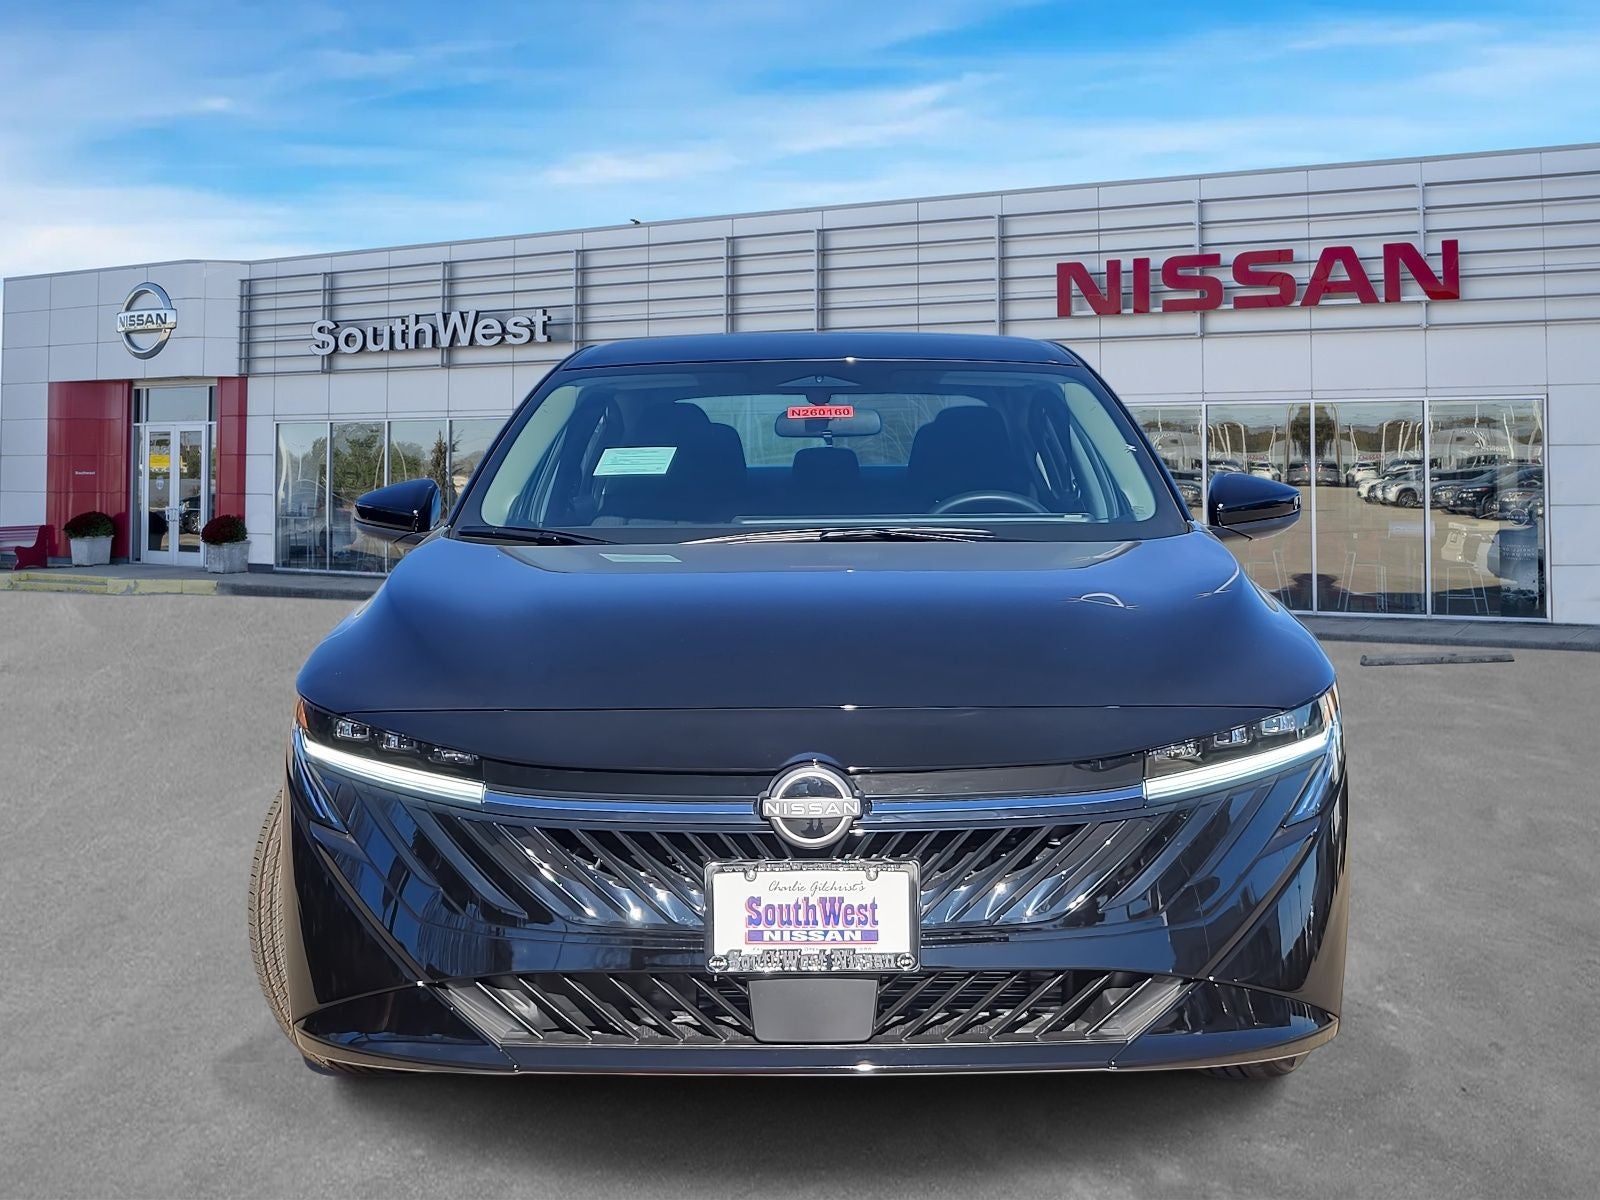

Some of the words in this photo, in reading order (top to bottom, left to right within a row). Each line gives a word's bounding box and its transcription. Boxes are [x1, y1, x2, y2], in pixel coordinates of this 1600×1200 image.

[1056, 239, 1460, 317] NISSAN
[119, 312, 167, 328] NISSAN
[309, 308, 552, 357] SouthWest
[764, 800, 860, 816] NISSAN
[768, 880, 807, 892] Charlie
[810, 880, 866, 897] Gilchrist's
[745, 896, 879, 928] SouthWest
[763, 930, 862, 941] NISSAN
